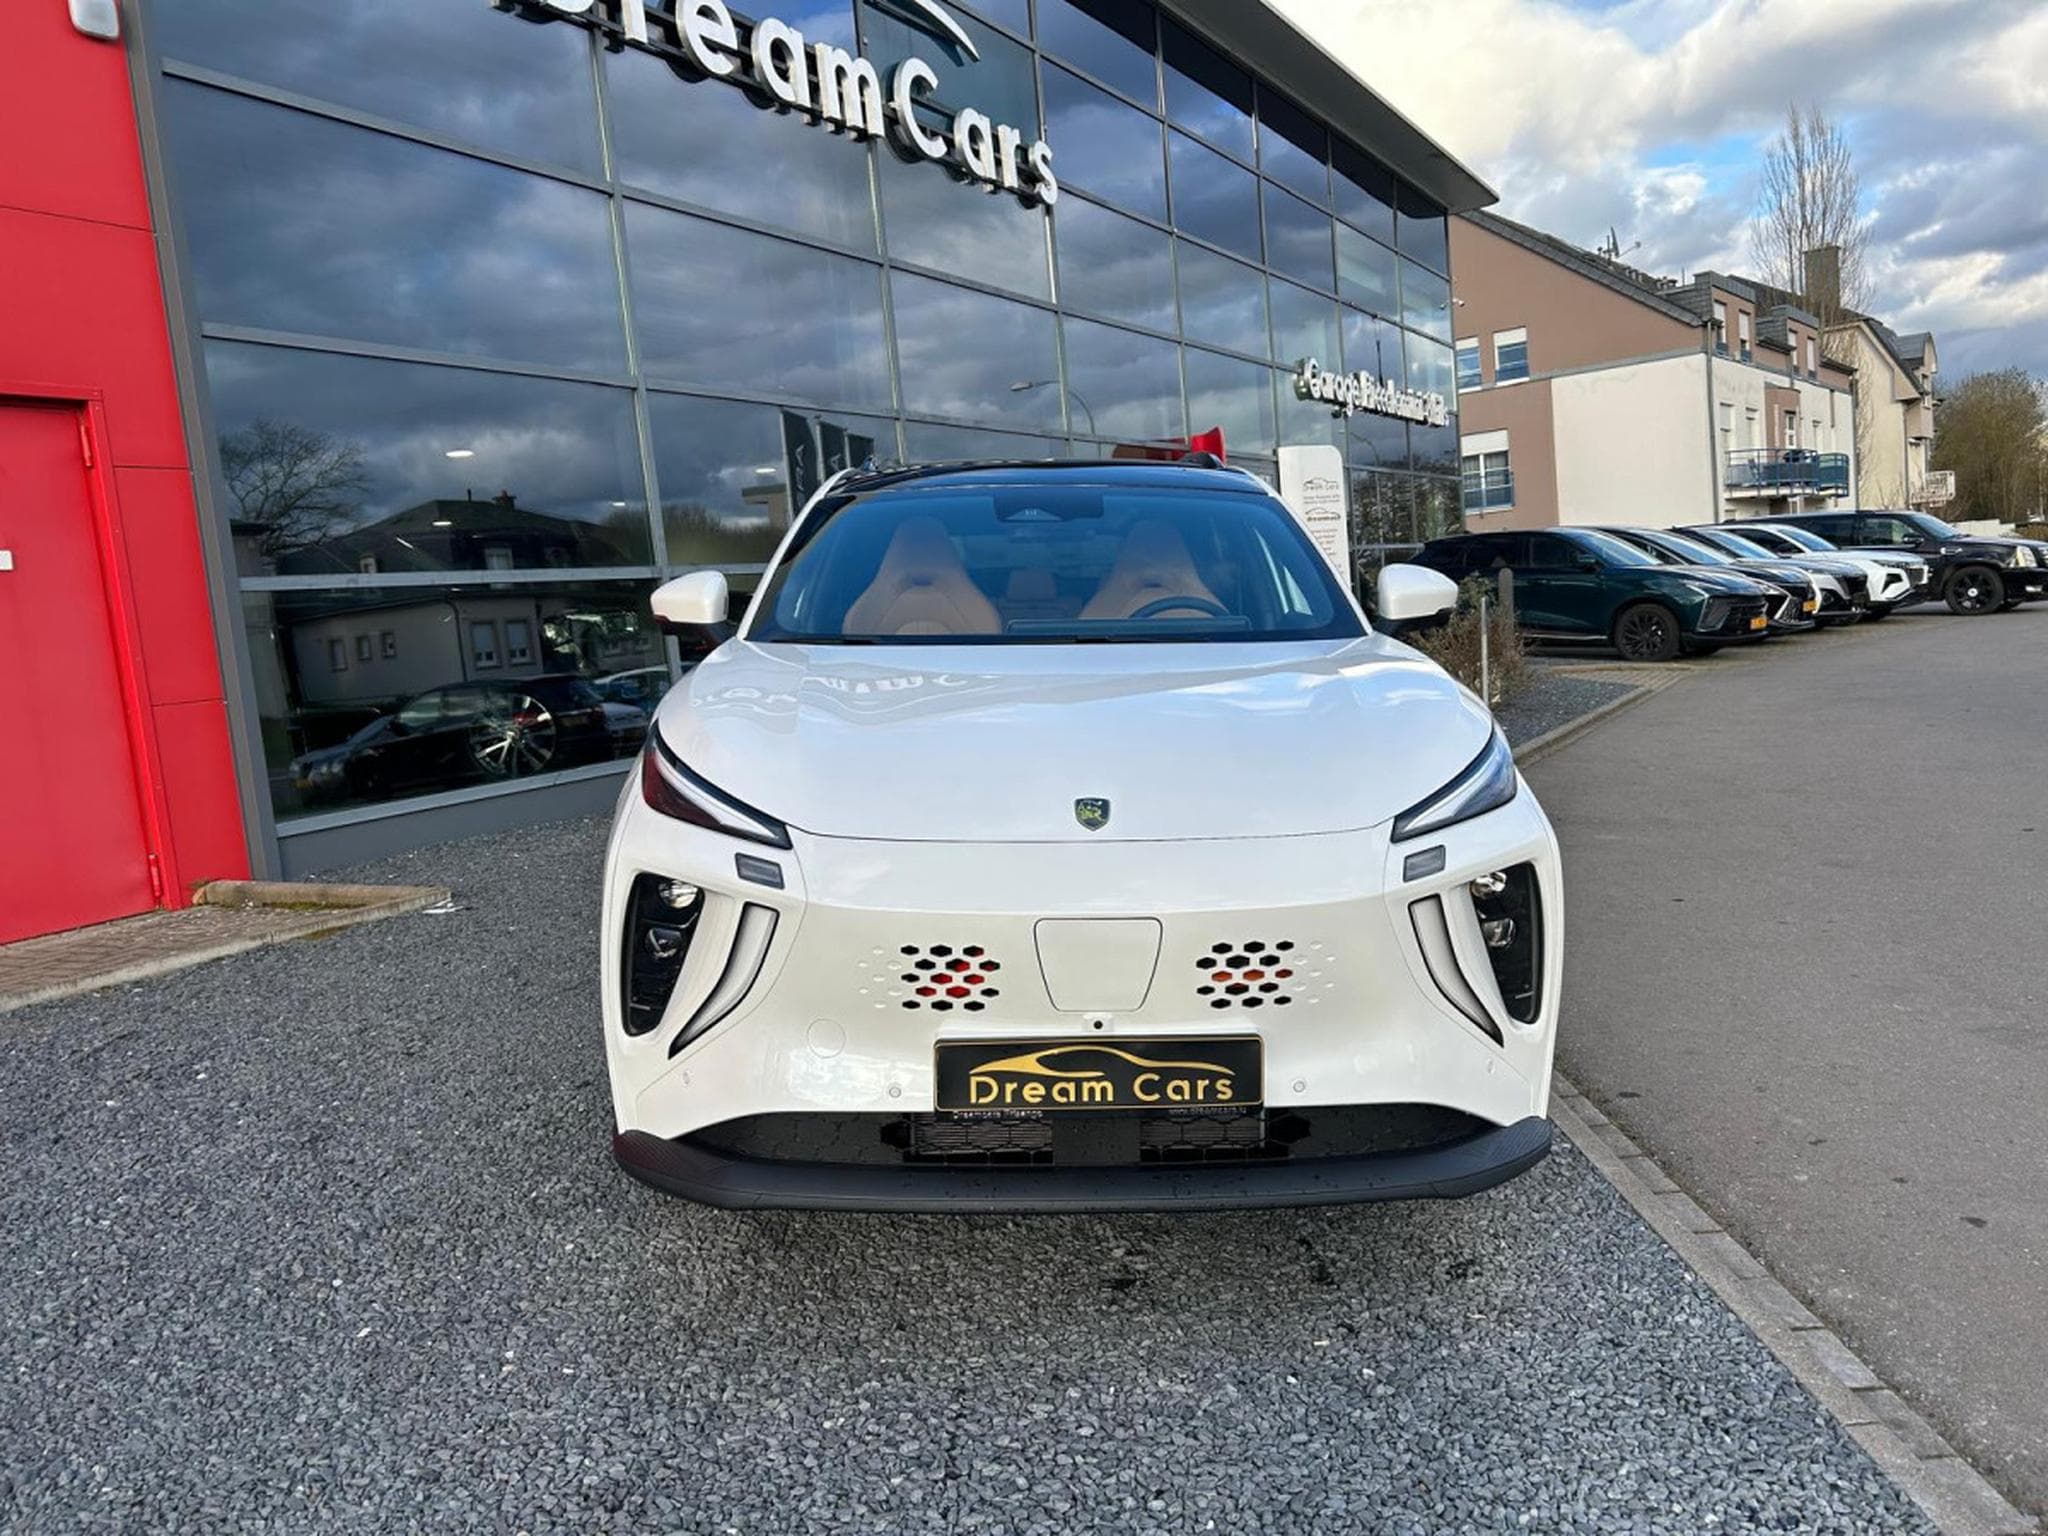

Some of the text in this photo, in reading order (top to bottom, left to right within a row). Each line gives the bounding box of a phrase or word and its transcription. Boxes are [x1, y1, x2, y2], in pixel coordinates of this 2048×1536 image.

[493, 0, 1058, 205] eam Cars
[1304, 357, 1361, 417] Garage
[969, 1073, 1234, 1104] Dream Cars
